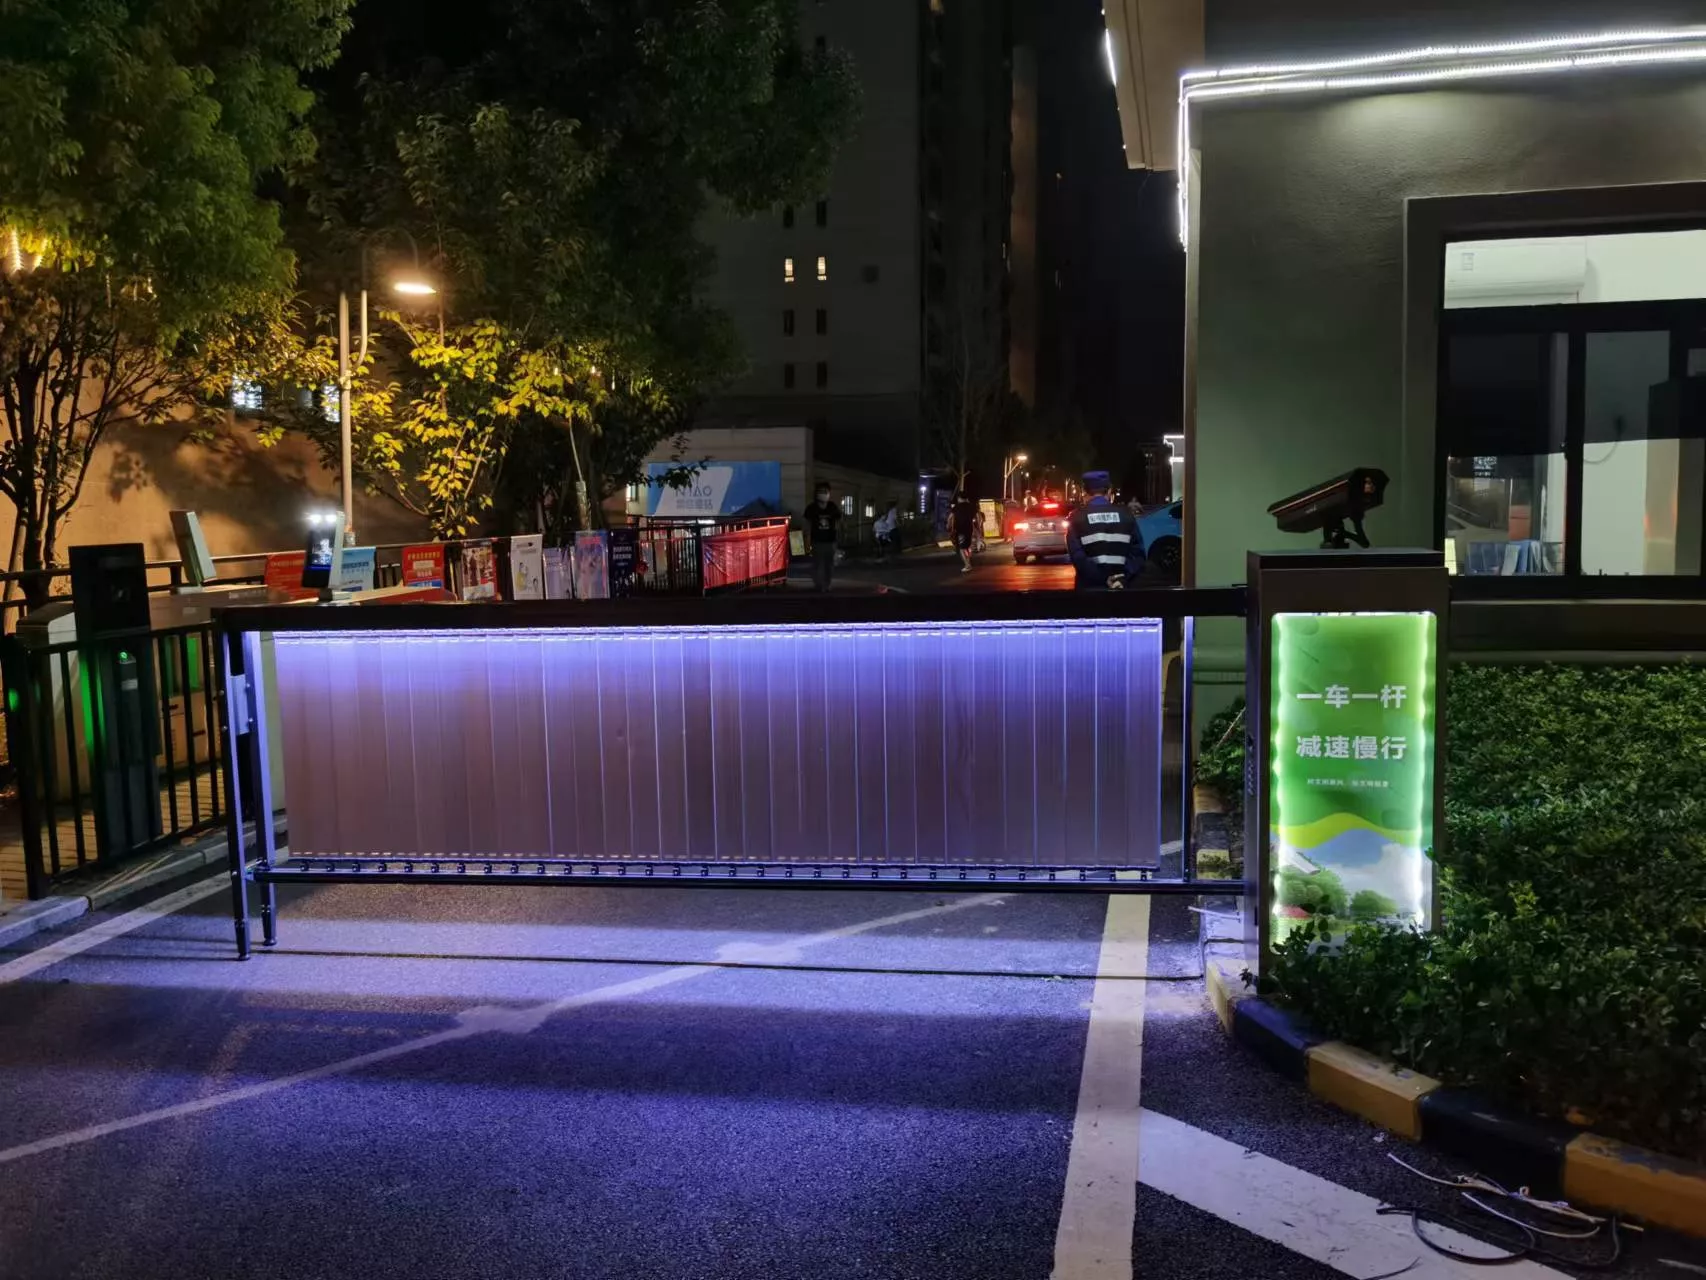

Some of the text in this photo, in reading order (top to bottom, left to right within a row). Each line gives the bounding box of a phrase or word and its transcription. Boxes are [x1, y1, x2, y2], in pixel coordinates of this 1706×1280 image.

[1296, 684, 1407, 708] 一车一杆
[1296, 735, 1407, 759] 减速慢行
